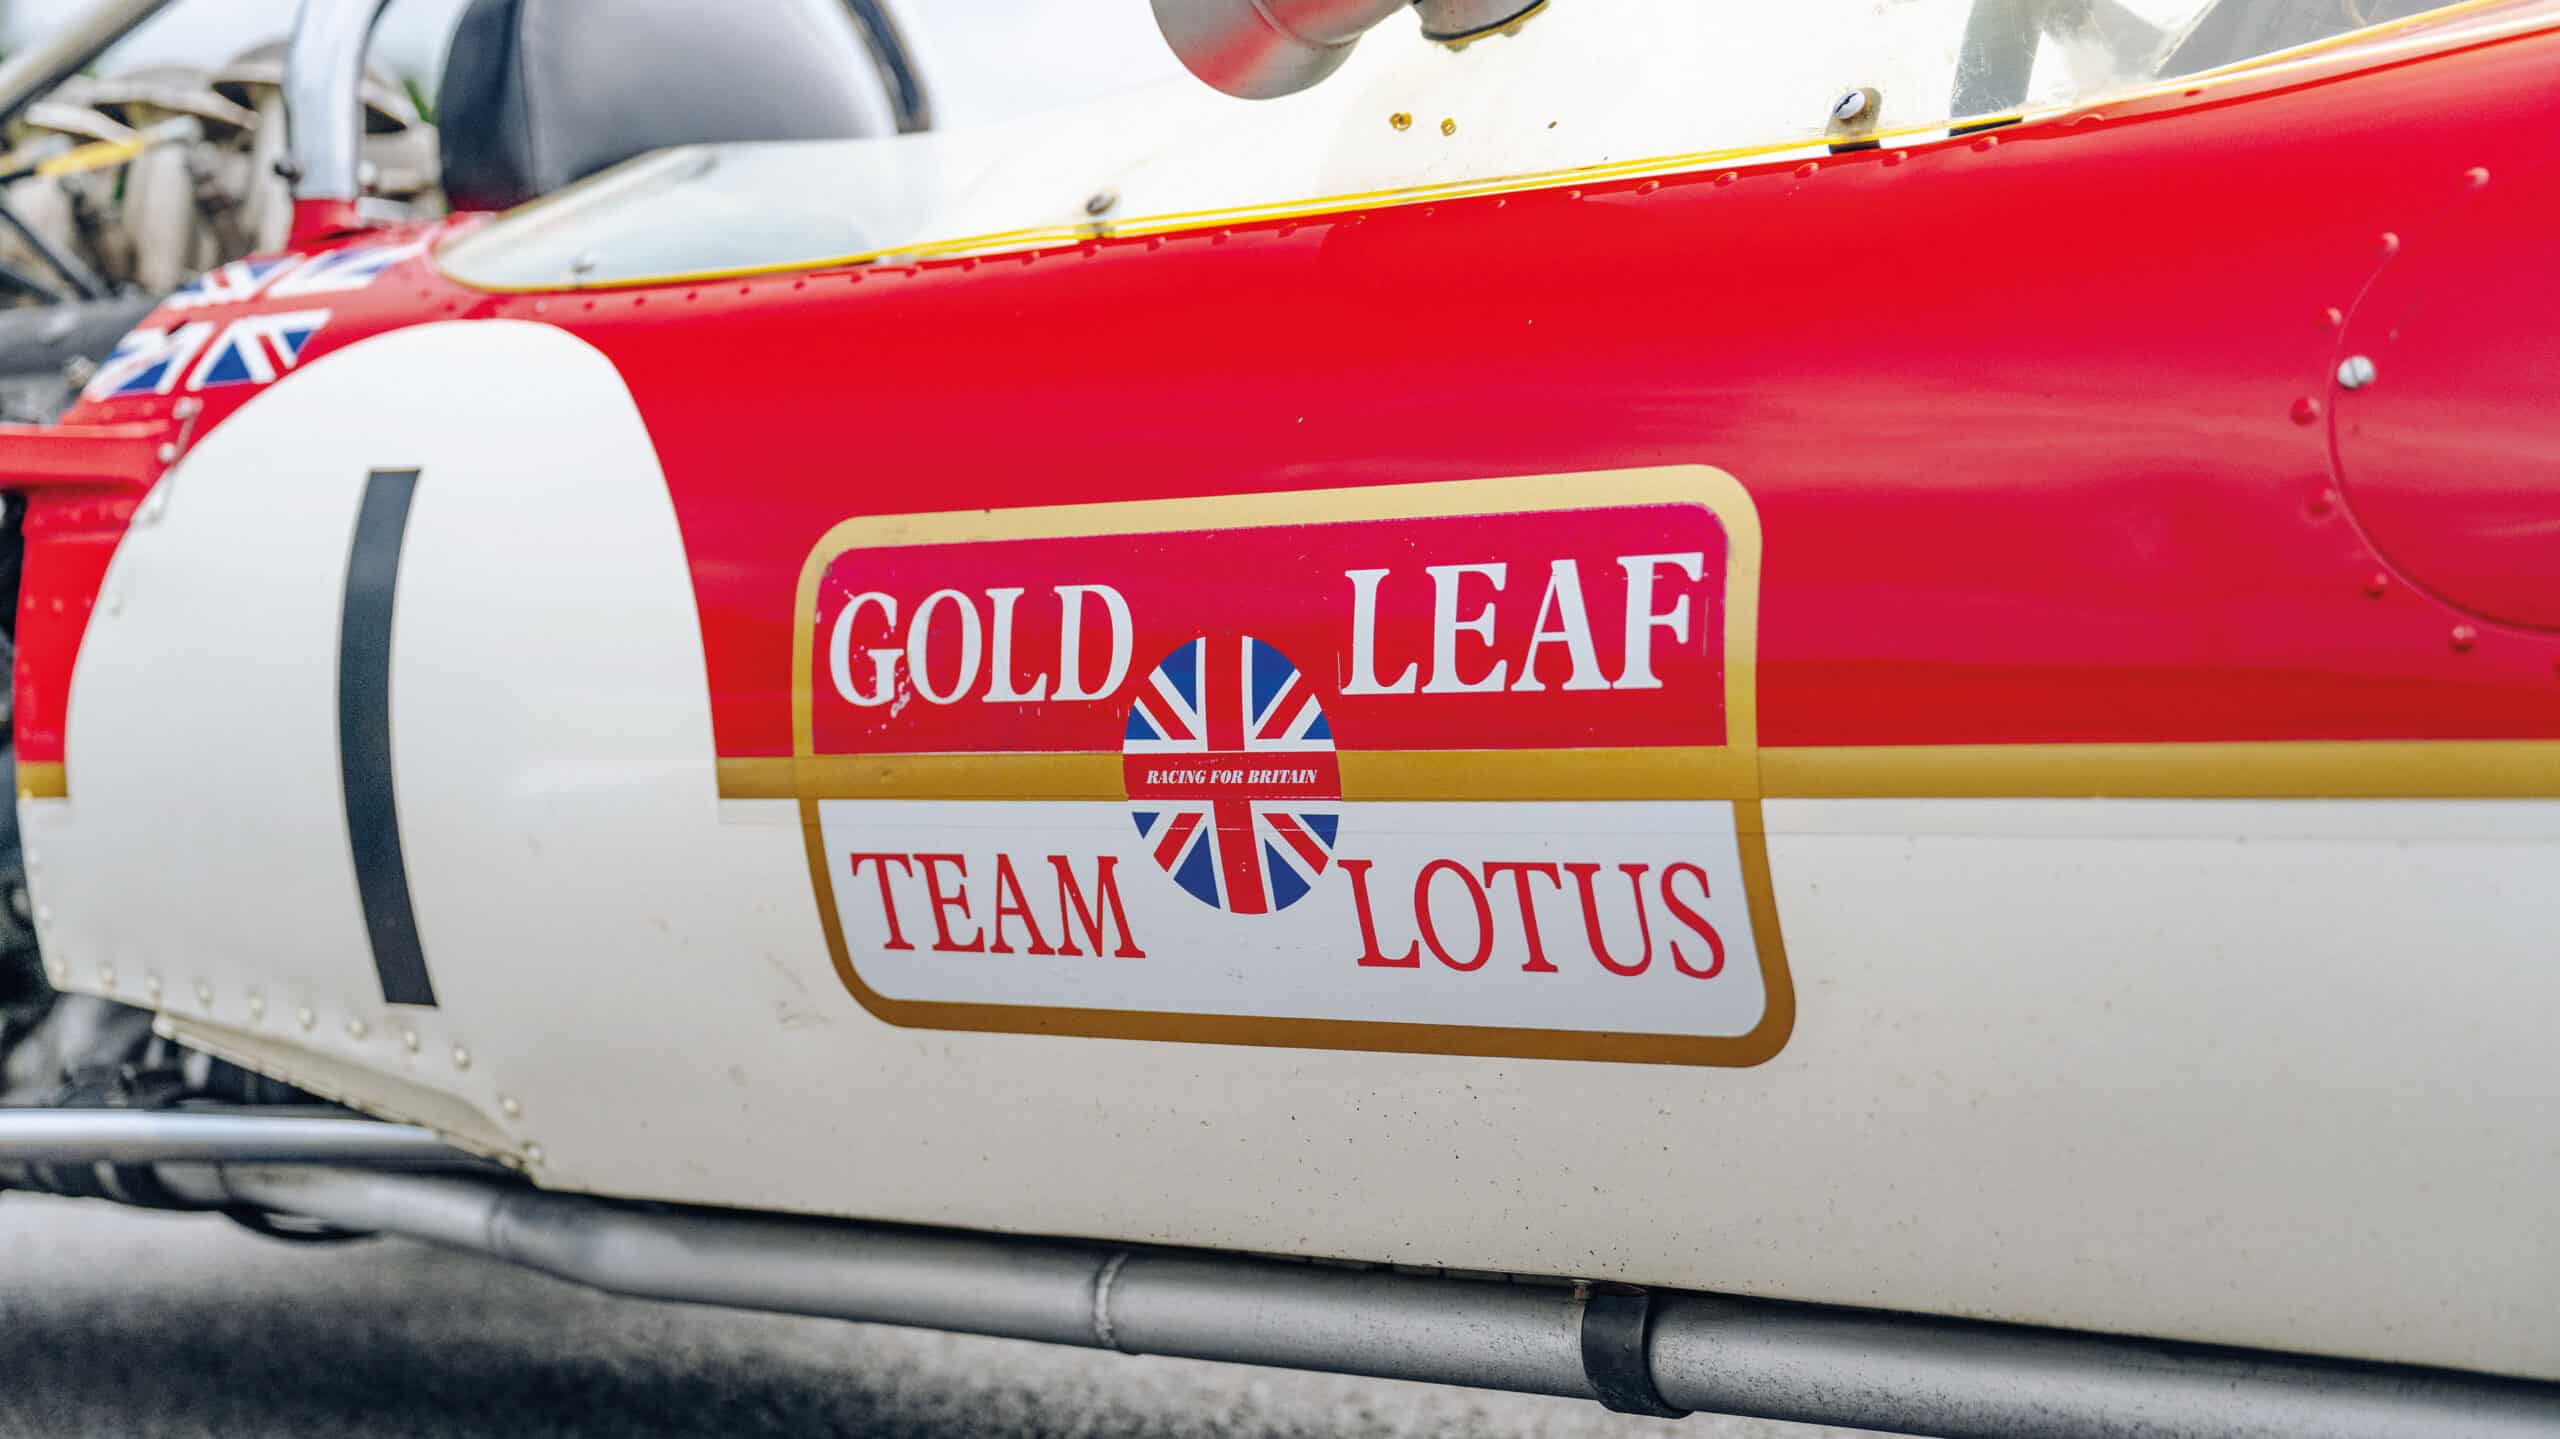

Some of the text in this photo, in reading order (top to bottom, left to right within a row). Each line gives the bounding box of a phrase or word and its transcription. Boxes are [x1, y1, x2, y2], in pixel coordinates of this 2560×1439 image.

[829, 552, 1704, 707] GOLD LEAF
[337, 467, 439, 1007] 1
[1146, 769, 1318, 784] RACING FOR BRITAIN
[850, 852, 1726, 980] TEAM LOTUS
